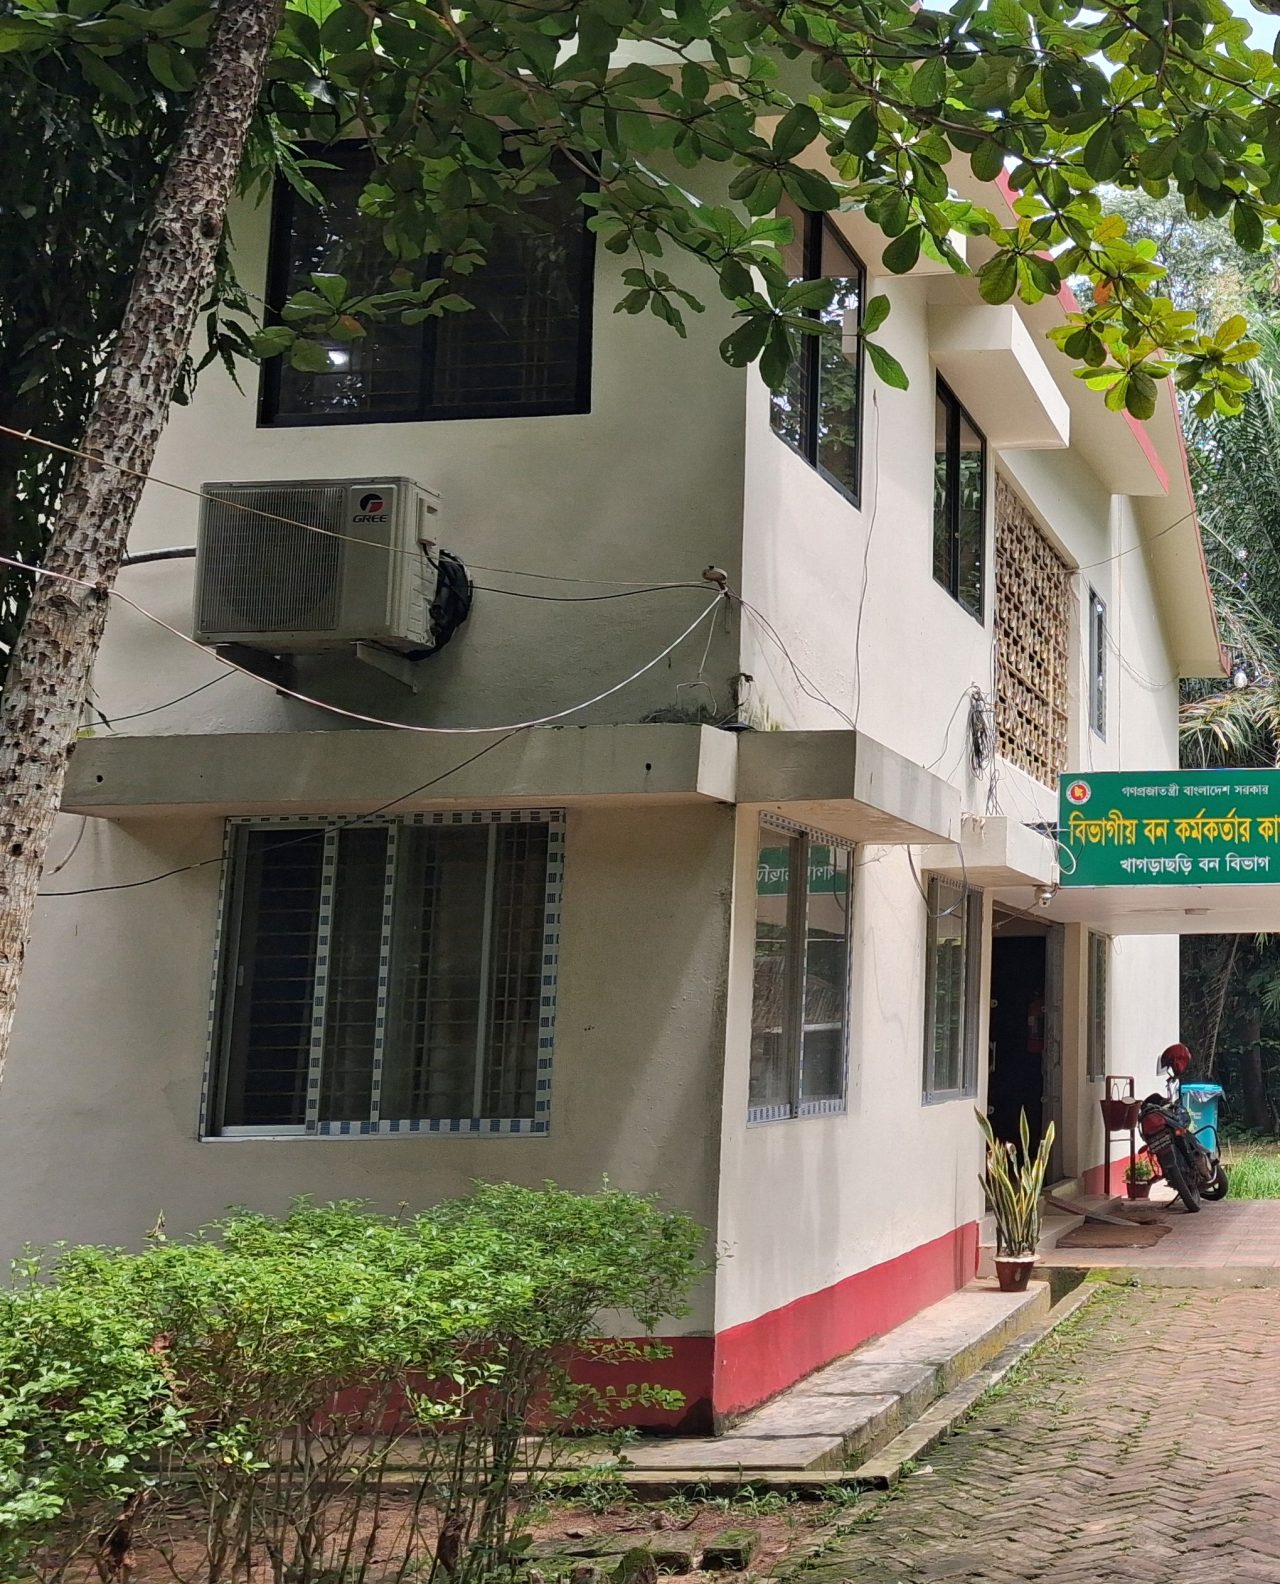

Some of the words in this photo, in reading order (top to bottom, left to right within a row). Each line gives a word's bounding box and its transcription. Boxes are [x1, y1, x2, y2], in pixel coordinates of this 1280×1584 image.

[352, 514, 388, 523] GREE
[1121, 783, 1179, 797] গণপ্রজাতন্ত্রী
[1183, 785, 1230, 797] বাংলাদেশ
[1234, 784, 1269, 796] সরকার
[1069, 809, 1138, 846] বিভাগীয়
[1143, 818, 1169, 845] বন
[1174, 808, 1252, 845] কর্মকর্তার
[1120, 854, 1192, 876] খাগড়াছড়ি
[1199, 857, 1219, 873] বন
[1226, 852, 1270, 873] বিভাগ
